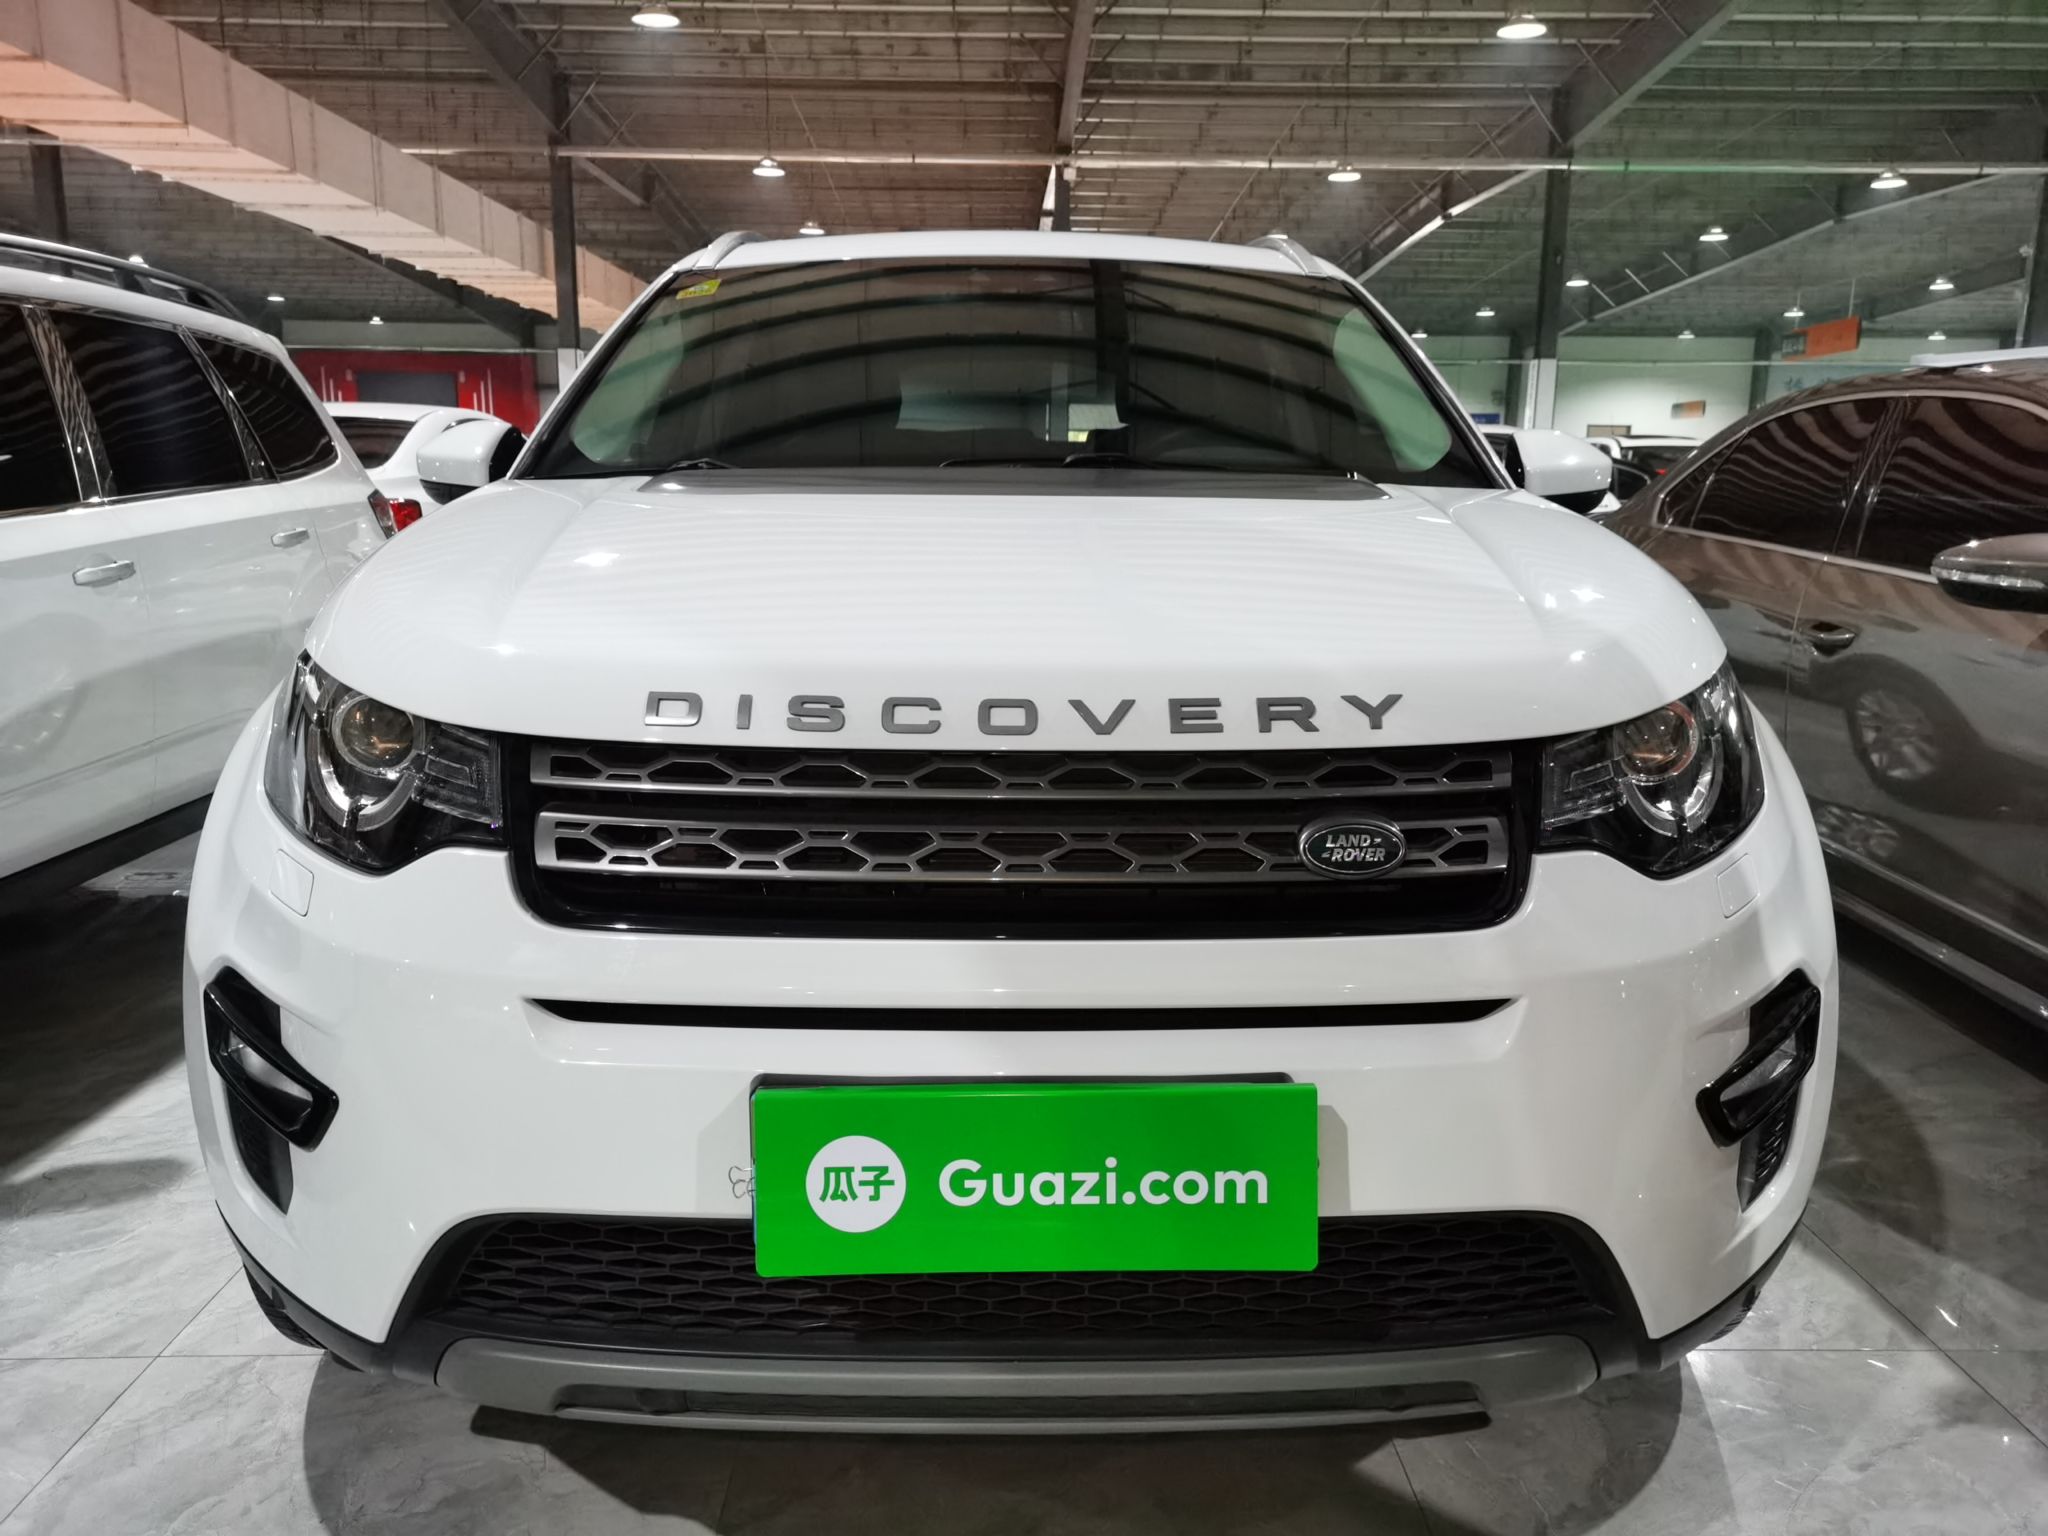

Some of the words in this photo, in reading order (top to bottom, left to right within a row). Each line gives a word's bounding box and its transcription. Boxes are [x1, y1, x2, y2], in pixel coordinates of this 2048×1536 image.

[645, 691, 1404, 736] DISCOVERY
[1325, 834, 1371, 848] LAND
[1331, 847, 1386, 862] ROVER
[818, 1165, 895, 1203] 瓜子
[938, 1156, 1269, 1207] Guazi.com
